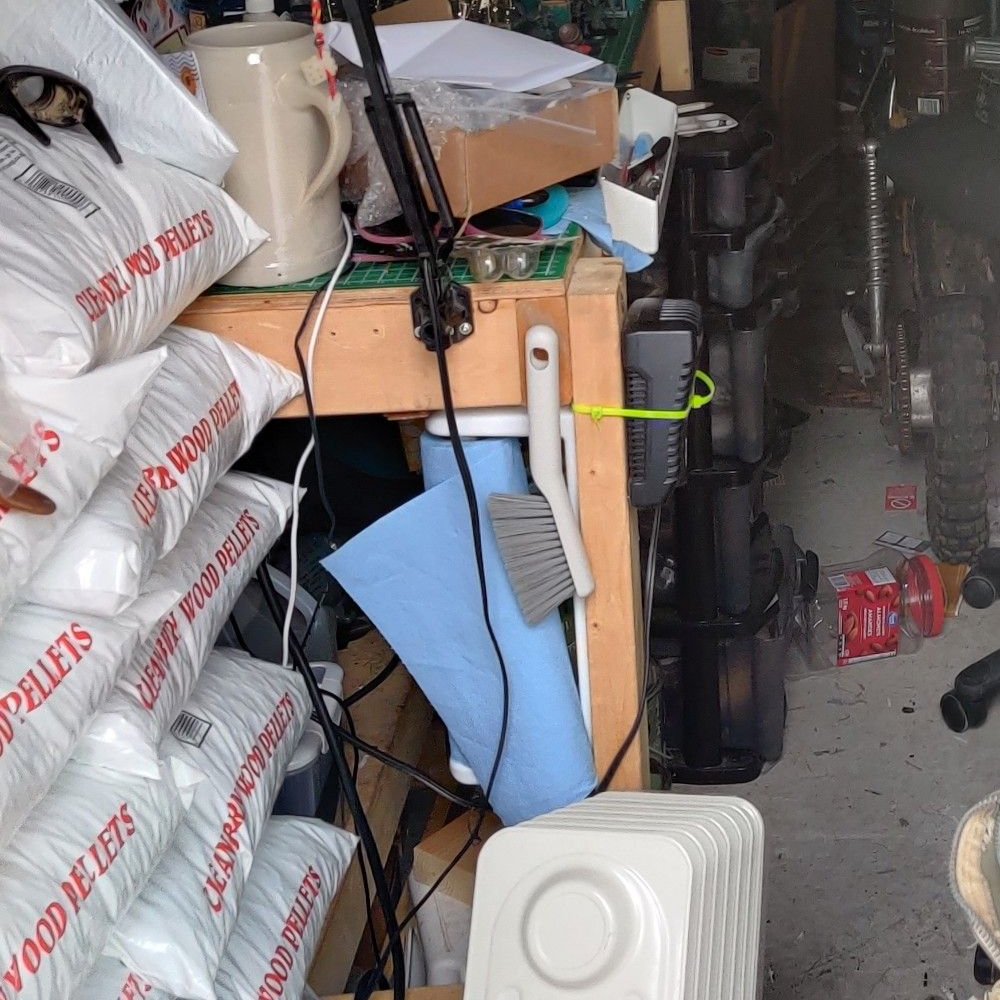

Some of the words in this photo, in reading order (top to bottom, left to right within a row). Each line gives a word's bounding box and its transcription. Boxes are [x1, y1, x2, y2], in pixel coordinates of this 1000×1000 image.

[154, 209, 215, 262] PELLETS
[166, 418, 213, 475] WOOD
[209, 380, 241, 433] PELLET
[179, 563, 220, 624] WOOD
[215, 508, 260, 577] PELLETS
[0, 622, 93, 725] PELLETS
[258, 692, 295, 758] PELLETS
[60, 802, 136, 915] PELLETS
[281, 865, 322, 953] PELLETS
